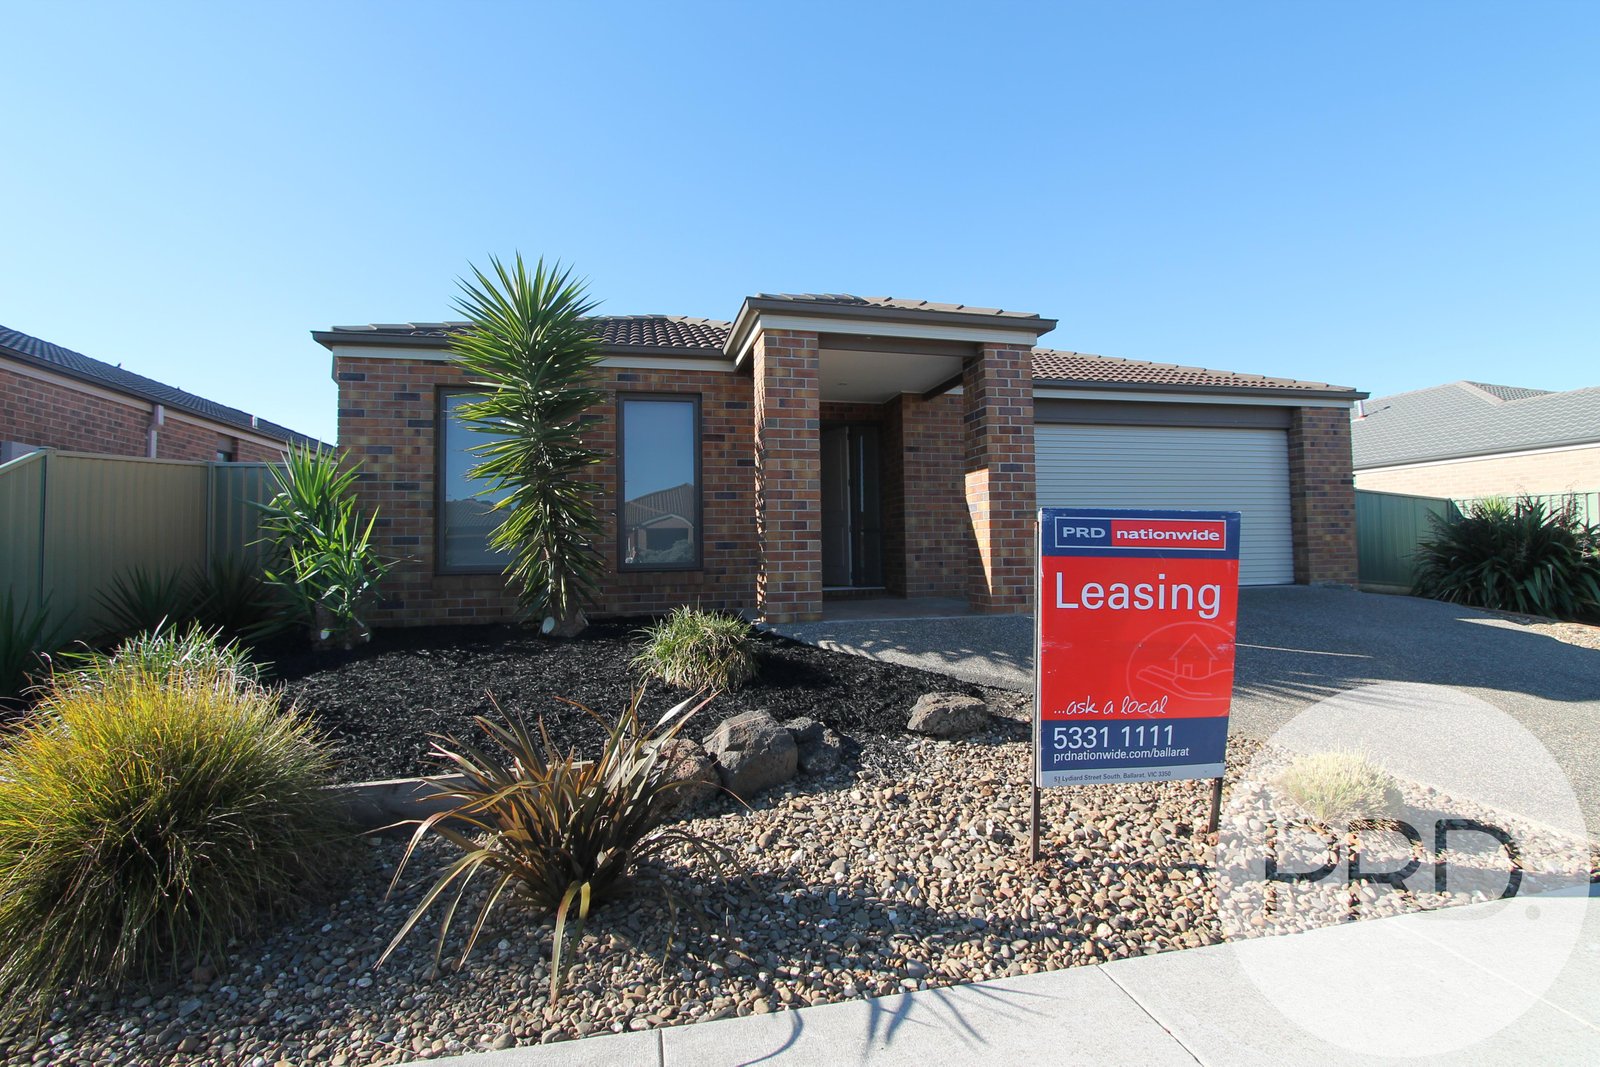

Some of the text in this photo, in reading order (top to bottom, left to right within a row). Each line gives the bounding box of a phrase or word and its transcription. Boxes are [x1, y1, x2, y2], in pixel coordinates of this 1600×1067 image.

[1062, 526, 1220, 541] PRD nationwide
[1056, 571, 1221, 620] Leasing
[1103, 699, 1114, 714] a
[1120, 695, 1168, 715] local
[1053, 724, 1173, 749] 5331 1111
[1053, 747, 1189, 764] prdnationwide.com/ballarat
[1084, 773, 1102, 782] Street
[1147, 770, 1157, 778] VIC
